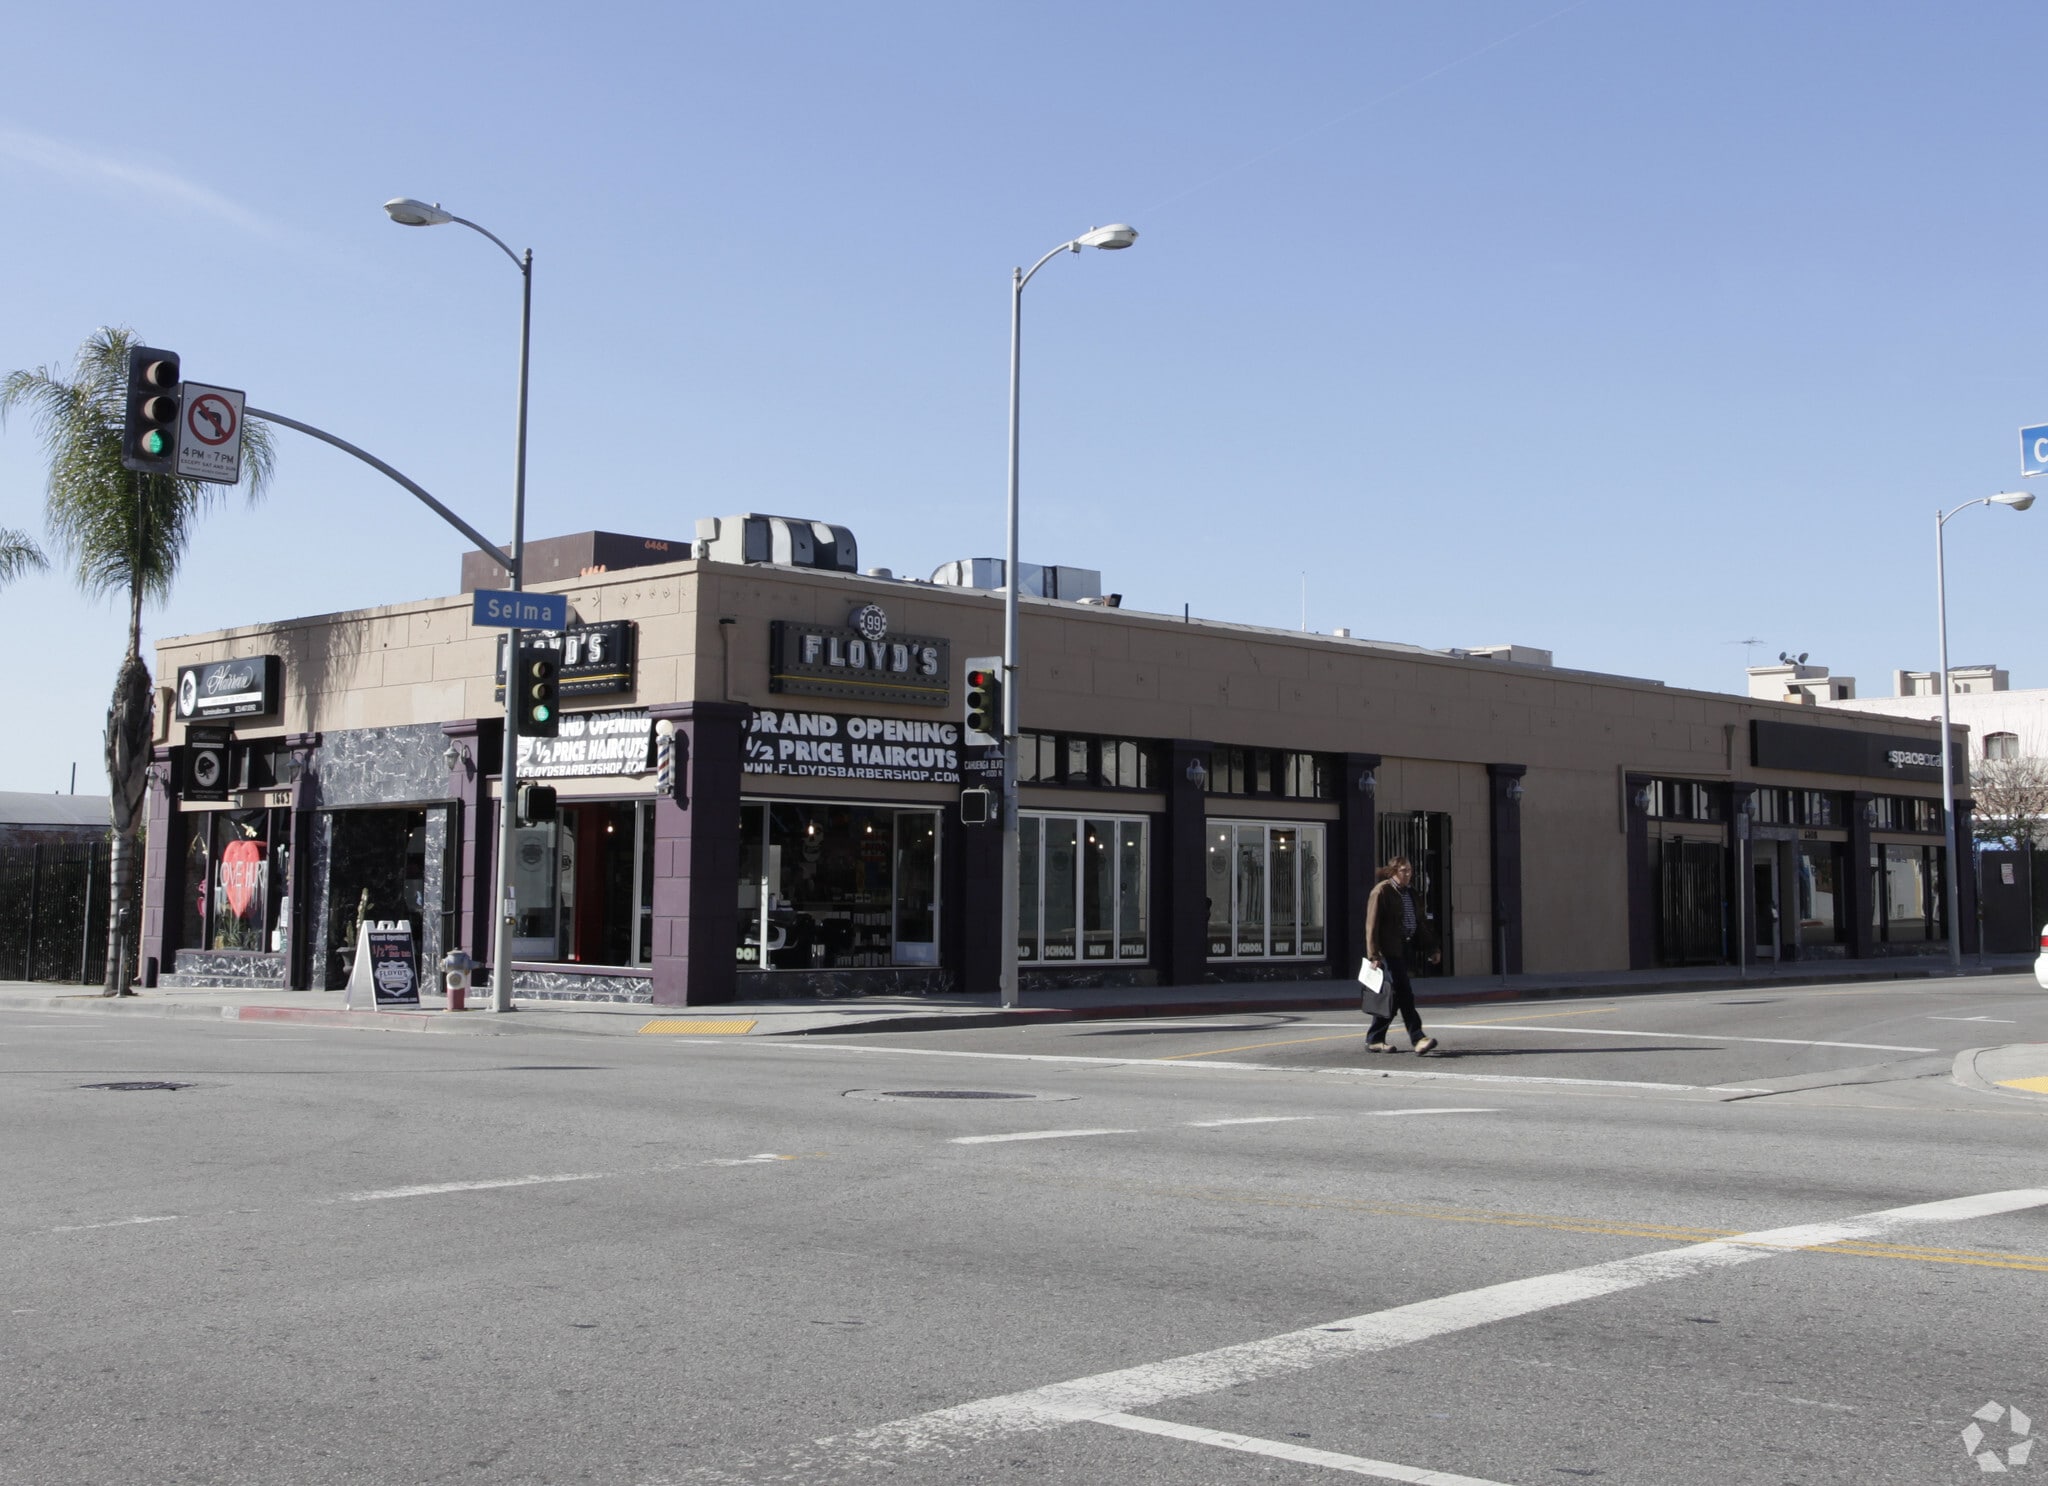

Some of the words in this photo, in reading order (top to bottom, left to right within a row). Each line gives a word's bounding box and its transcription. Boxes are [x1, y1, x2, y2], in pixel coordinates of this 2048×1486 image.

[182, 447, 190, 457] 4
[191, 449, 205, 460] PM
[214, 451, 221, 462] 7
[221, 454, 235, 465] PM
[487, 598, 552, 621] Selma
[867, 615, 881, 631] 99
[804, 634, 938, 676] FLOYD'S
[588, 711, 652, 736] OPENING
[741, 710, 838, 737] GRAND
[846, 717, 958, 745] OPENING
[551, 740, 587, 762] PRICE
[587, 736, 649, 761] HAIRCUTS
[778, 739, 844, 763] PRICE
[851, 743, 958, 769] HAIRCUTS
[743, 762, 960, 783] WWW.FLOYDSBARBERSHOP.COM
[214, 859, 244, 892] LOVE
[1017, 946, 1030, 957] LD
[1045, 945, 1075, 957] SCHOOL
[1089, 944, 1106, 956] NEW
[1121, 944, 1145, 955] STYLES
[1212, 943, 1226, 954] OLD
[1238, 943, 1263, 953] SCHOOL
[1275, 942, 1290, 953] NEW
[1302, 942, 1322, 952] STYLES
